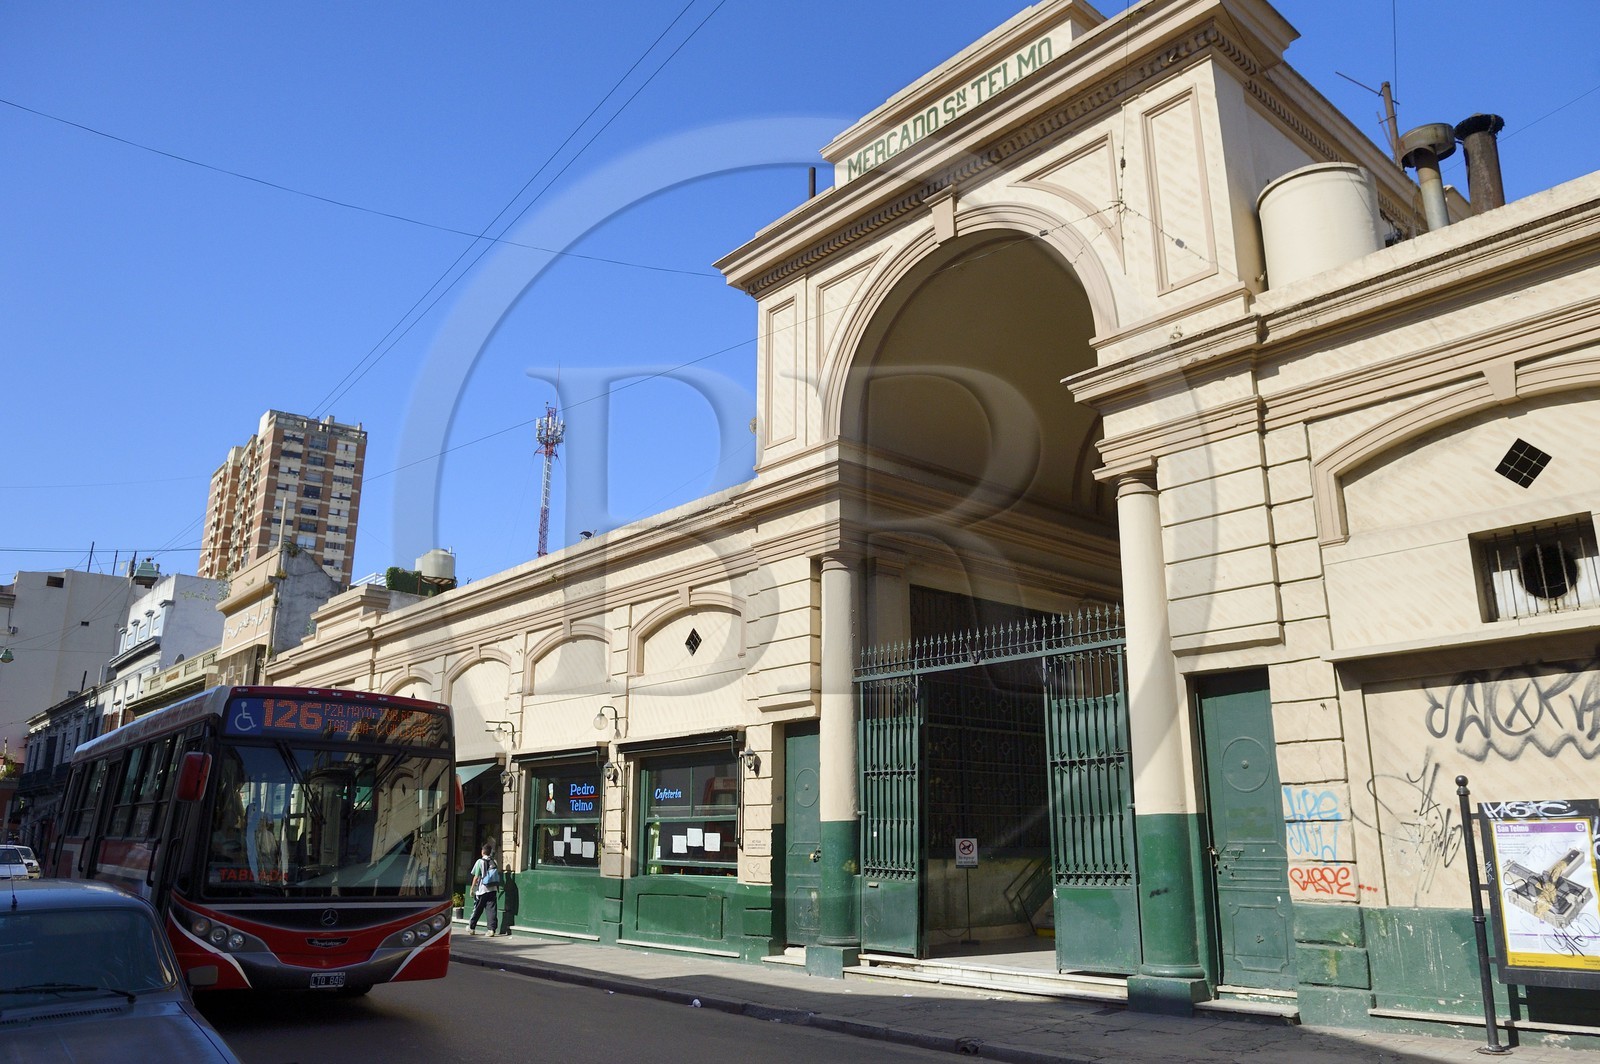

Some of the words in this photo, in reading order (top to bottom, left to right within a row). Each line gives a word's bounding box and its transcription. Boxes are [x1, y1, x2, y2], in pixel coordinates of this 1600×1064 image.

[847, 106, 939, 182] MERCADO
[971, 36, 1053, 104] TELMO
[262, 698, 322, 730] 126
[570, 783, 595, 796] Pedro
[570, 799, 593, 811] Telmo
[1497, 824, 1509, 833] San
[1510, 824, 1529, 833] Telmo
